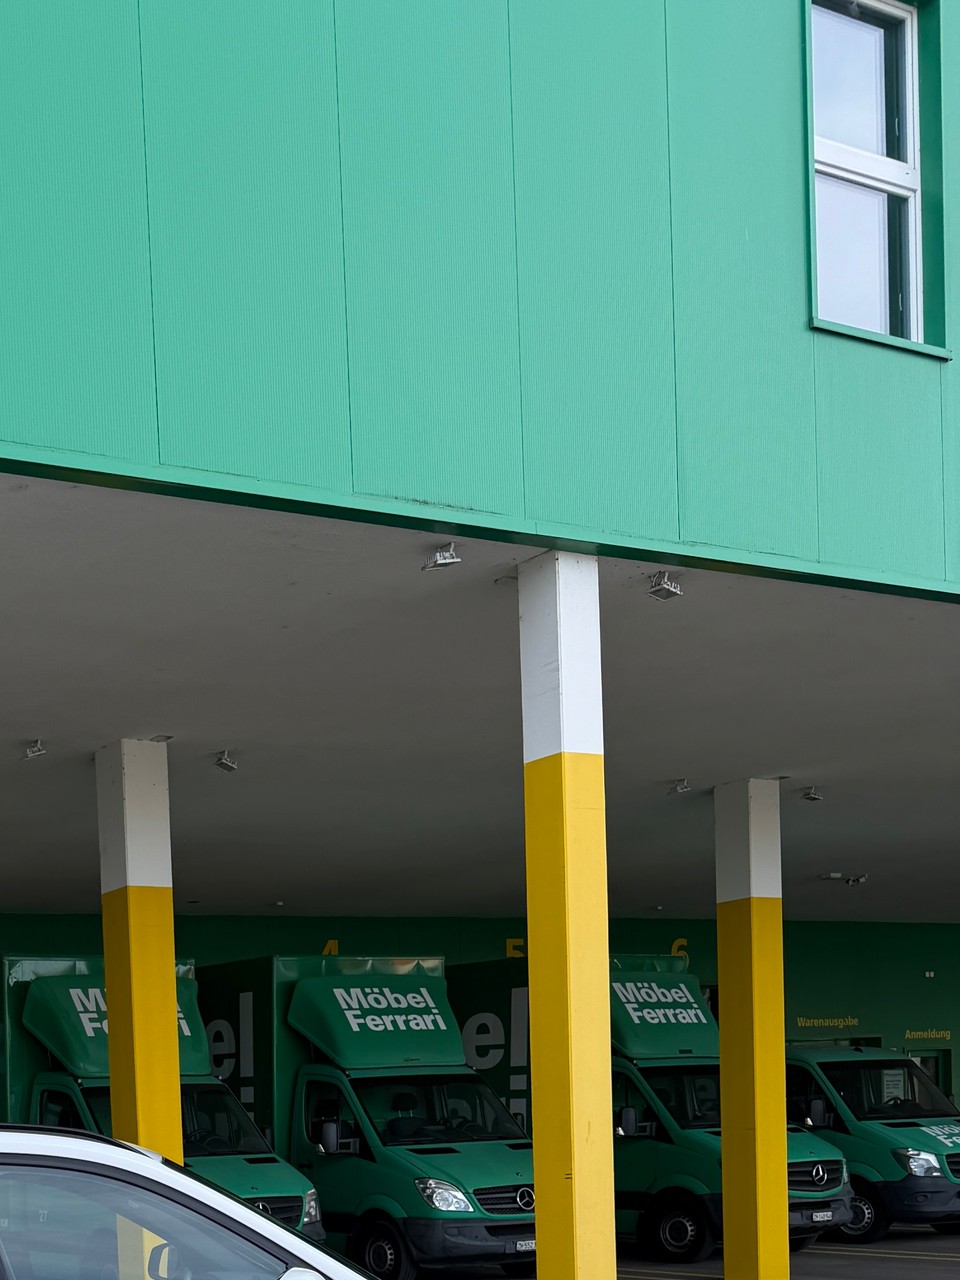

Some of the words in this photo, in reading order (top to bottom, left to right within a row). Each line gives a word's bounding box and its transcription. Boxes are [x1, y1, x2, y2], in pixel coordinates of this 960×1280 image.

[332, 987, 437, 1009] Möbel
[612, 982, 696, 1003] Möbel
[343, 1008, 448, 1032] Ferrari
[623, 1003, 708, 1024] Ferrari
[797, 1016, 859, 1029] Warenausgabe
[904, 1029, 951, 1041] Anmeldung
